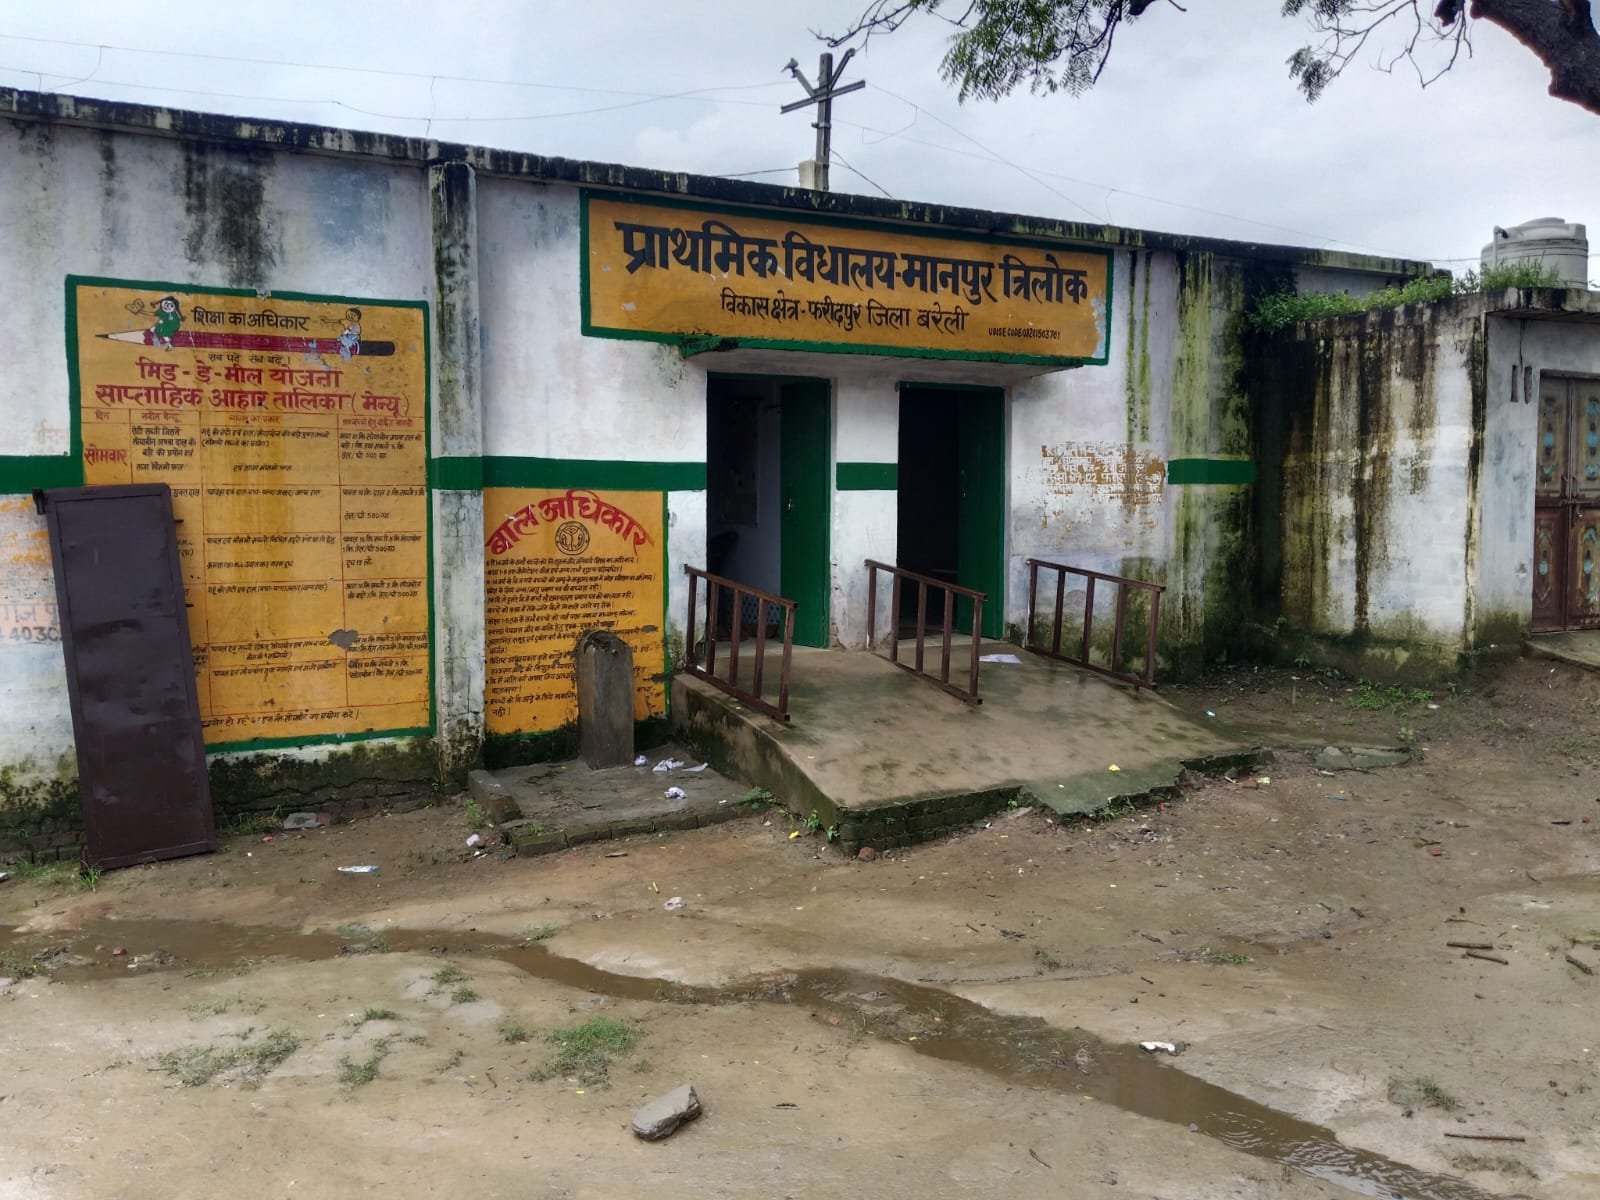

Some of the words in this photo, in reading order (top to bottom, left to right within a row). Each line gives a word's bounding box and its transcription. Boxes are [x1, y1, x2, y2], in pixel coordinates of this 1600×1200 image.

[614, 220, 778, 278] प्राथमिक
[998, 253, 1088, 304] त्रिलोक
[190, 306, 226, 326] शिक्षा
[227, 311, 246, 326] का
[246, 309, 310, 331] अधिकार
[720, 287, 770, 319] विकास
[807, 296, 861, 332] फरीदपुर
[866, 298, 912, 330] जिला
[917, 302, 970, 334] बरेली
[136, 356, 180, 381] मिड
[195, 359, 213, 384] डे
[223, 364, 264, 387] मील
[269, 364, 344, 388] योजना
[96, 381, 203, 408] साप्ताहिक
[208, 389, 269, 409] आहार
[273, 387, 351, 410] तालिका
[84, 443, 129, 466] सोमवार
[485, 503, 540, 555] बाल
[538, 489, 655, 556] अधिकार
